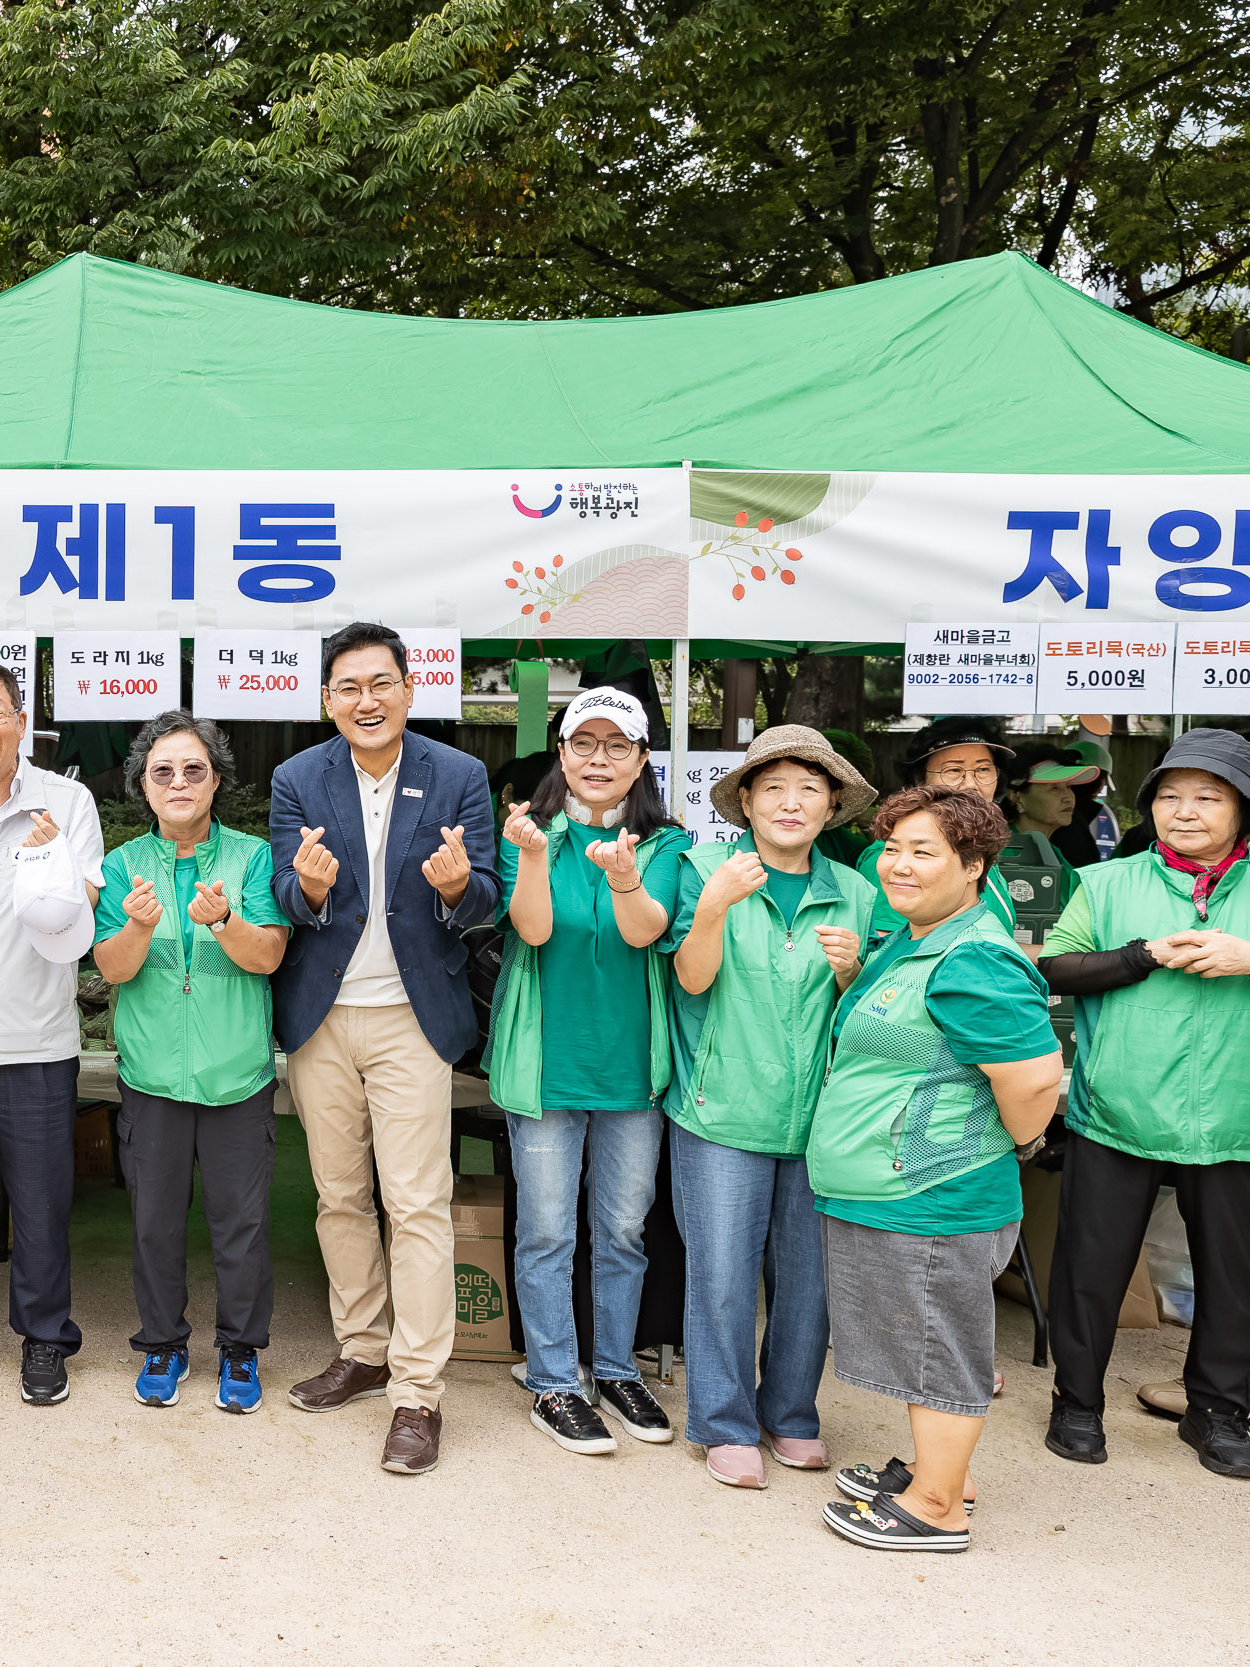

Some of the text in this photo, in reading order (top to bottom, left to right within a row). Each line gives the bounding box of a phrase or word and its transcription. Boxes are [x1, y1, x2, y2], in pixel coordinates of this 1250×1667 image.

[569, 482, 638, 496] 소통하며 발전하는
[569, 495, 638, 519] 행복광진
[934, 629, 1011, 644] 새마을금고
[1045, 640, 1167, 657] 도토리묵(국산)
[137, 651, 164, 667] 1kg
[271, 650, 298, 666] 1kg
[907, 653, 1036, 666] (제향란 새마을부녀회)
[239, 674, 299, 692] 25,000
[908, 673, 1033, 684] 9002-2056-1742-8
[1067, 669, 1145, 688] 5,000원
[99, 679, 158, 697] 16,000
[575, 694, 634, 714] Titleist
